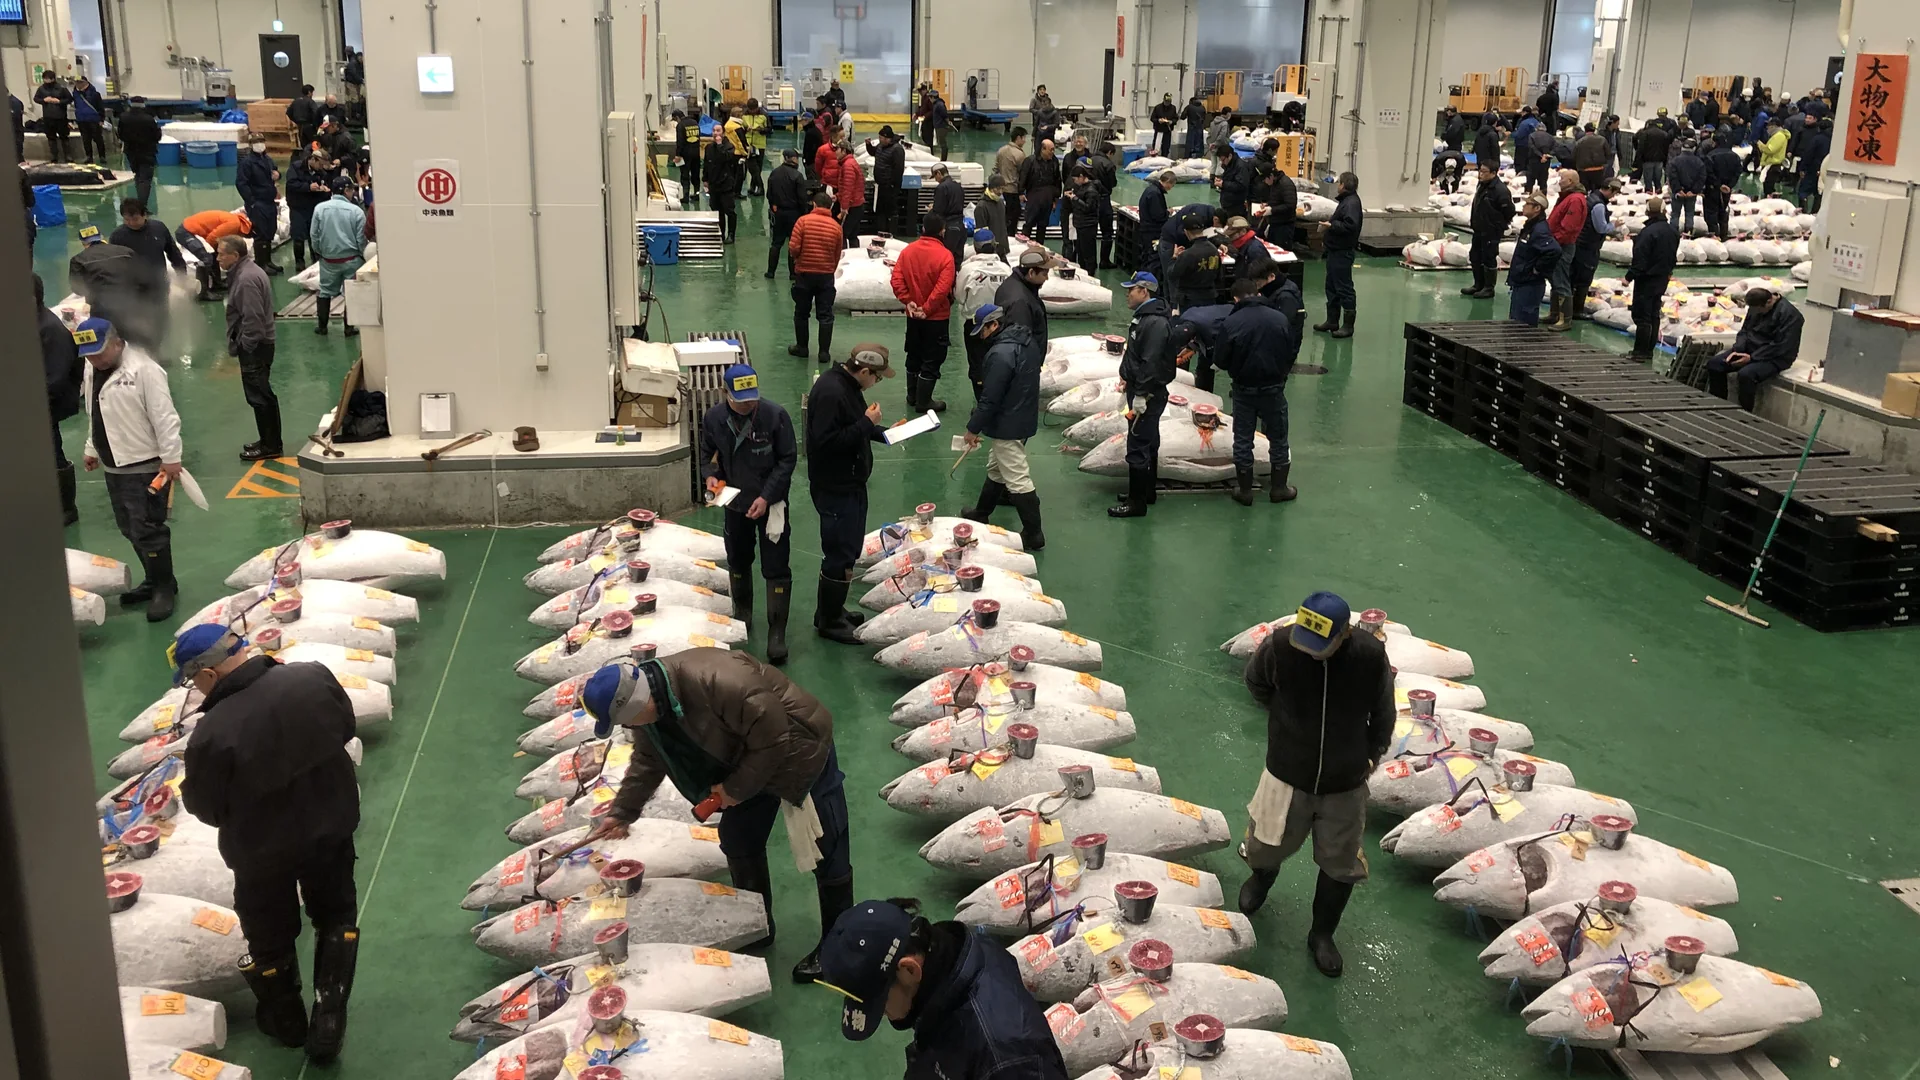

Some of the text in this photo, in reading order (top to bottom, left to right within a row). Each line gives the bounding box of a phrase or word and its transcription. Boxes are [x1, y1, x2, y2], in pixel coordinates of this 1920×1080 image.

[1854, 57, 1892, 161] 大物冷凍
[422, 208, 454, 217] 中央魚類
